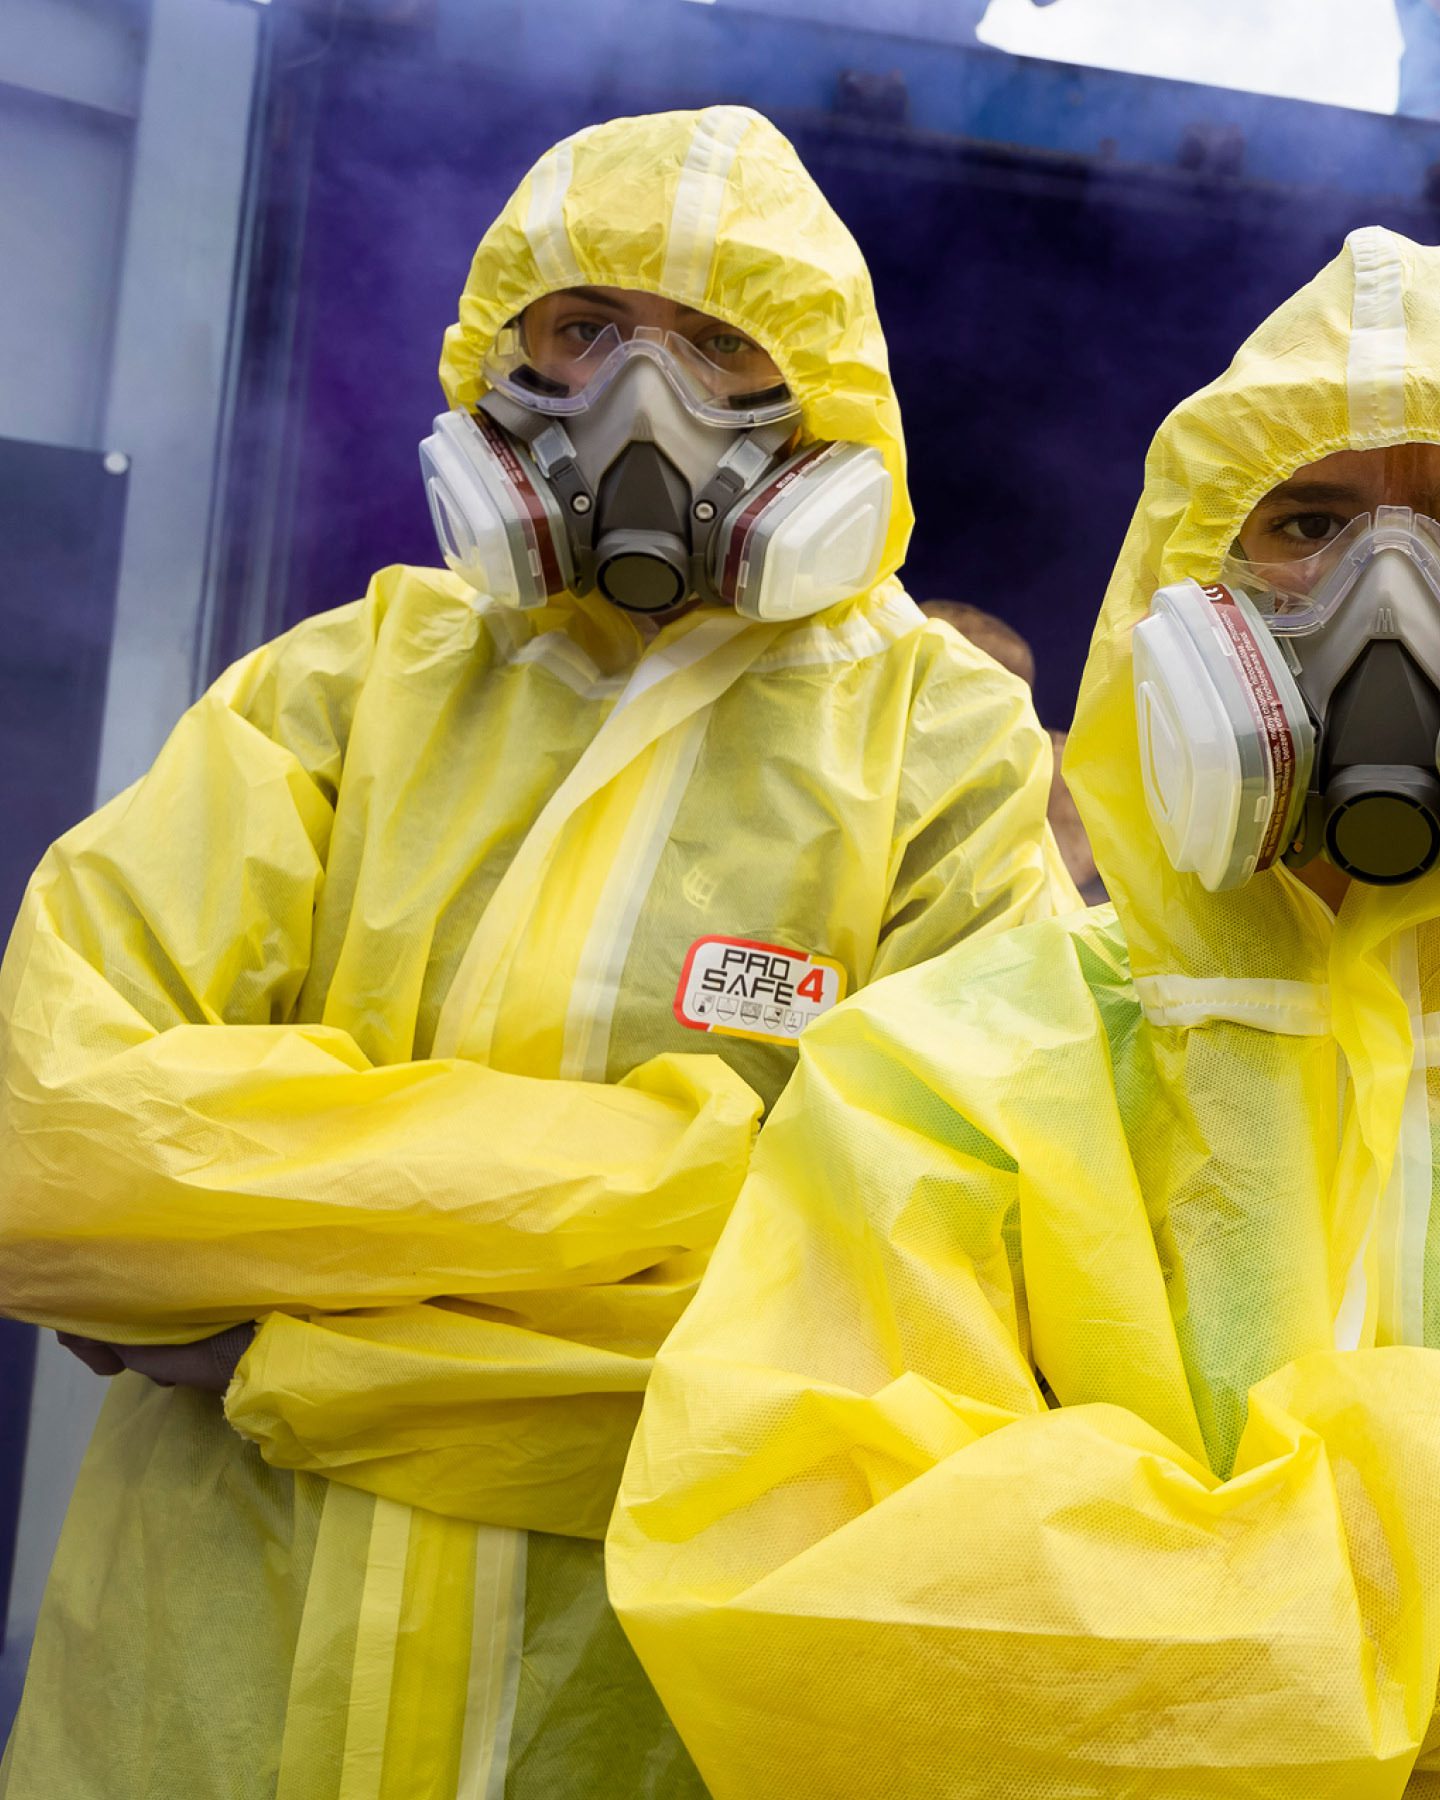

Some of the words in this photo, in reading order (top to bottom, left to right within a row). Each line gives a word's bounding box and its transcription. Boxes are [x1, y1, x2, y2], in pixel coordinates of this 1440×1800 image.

[721, 949, 790, 981] PRO
[701, 968, 794, 1006] SAFE
[796, 968, 825, 1003] 4
